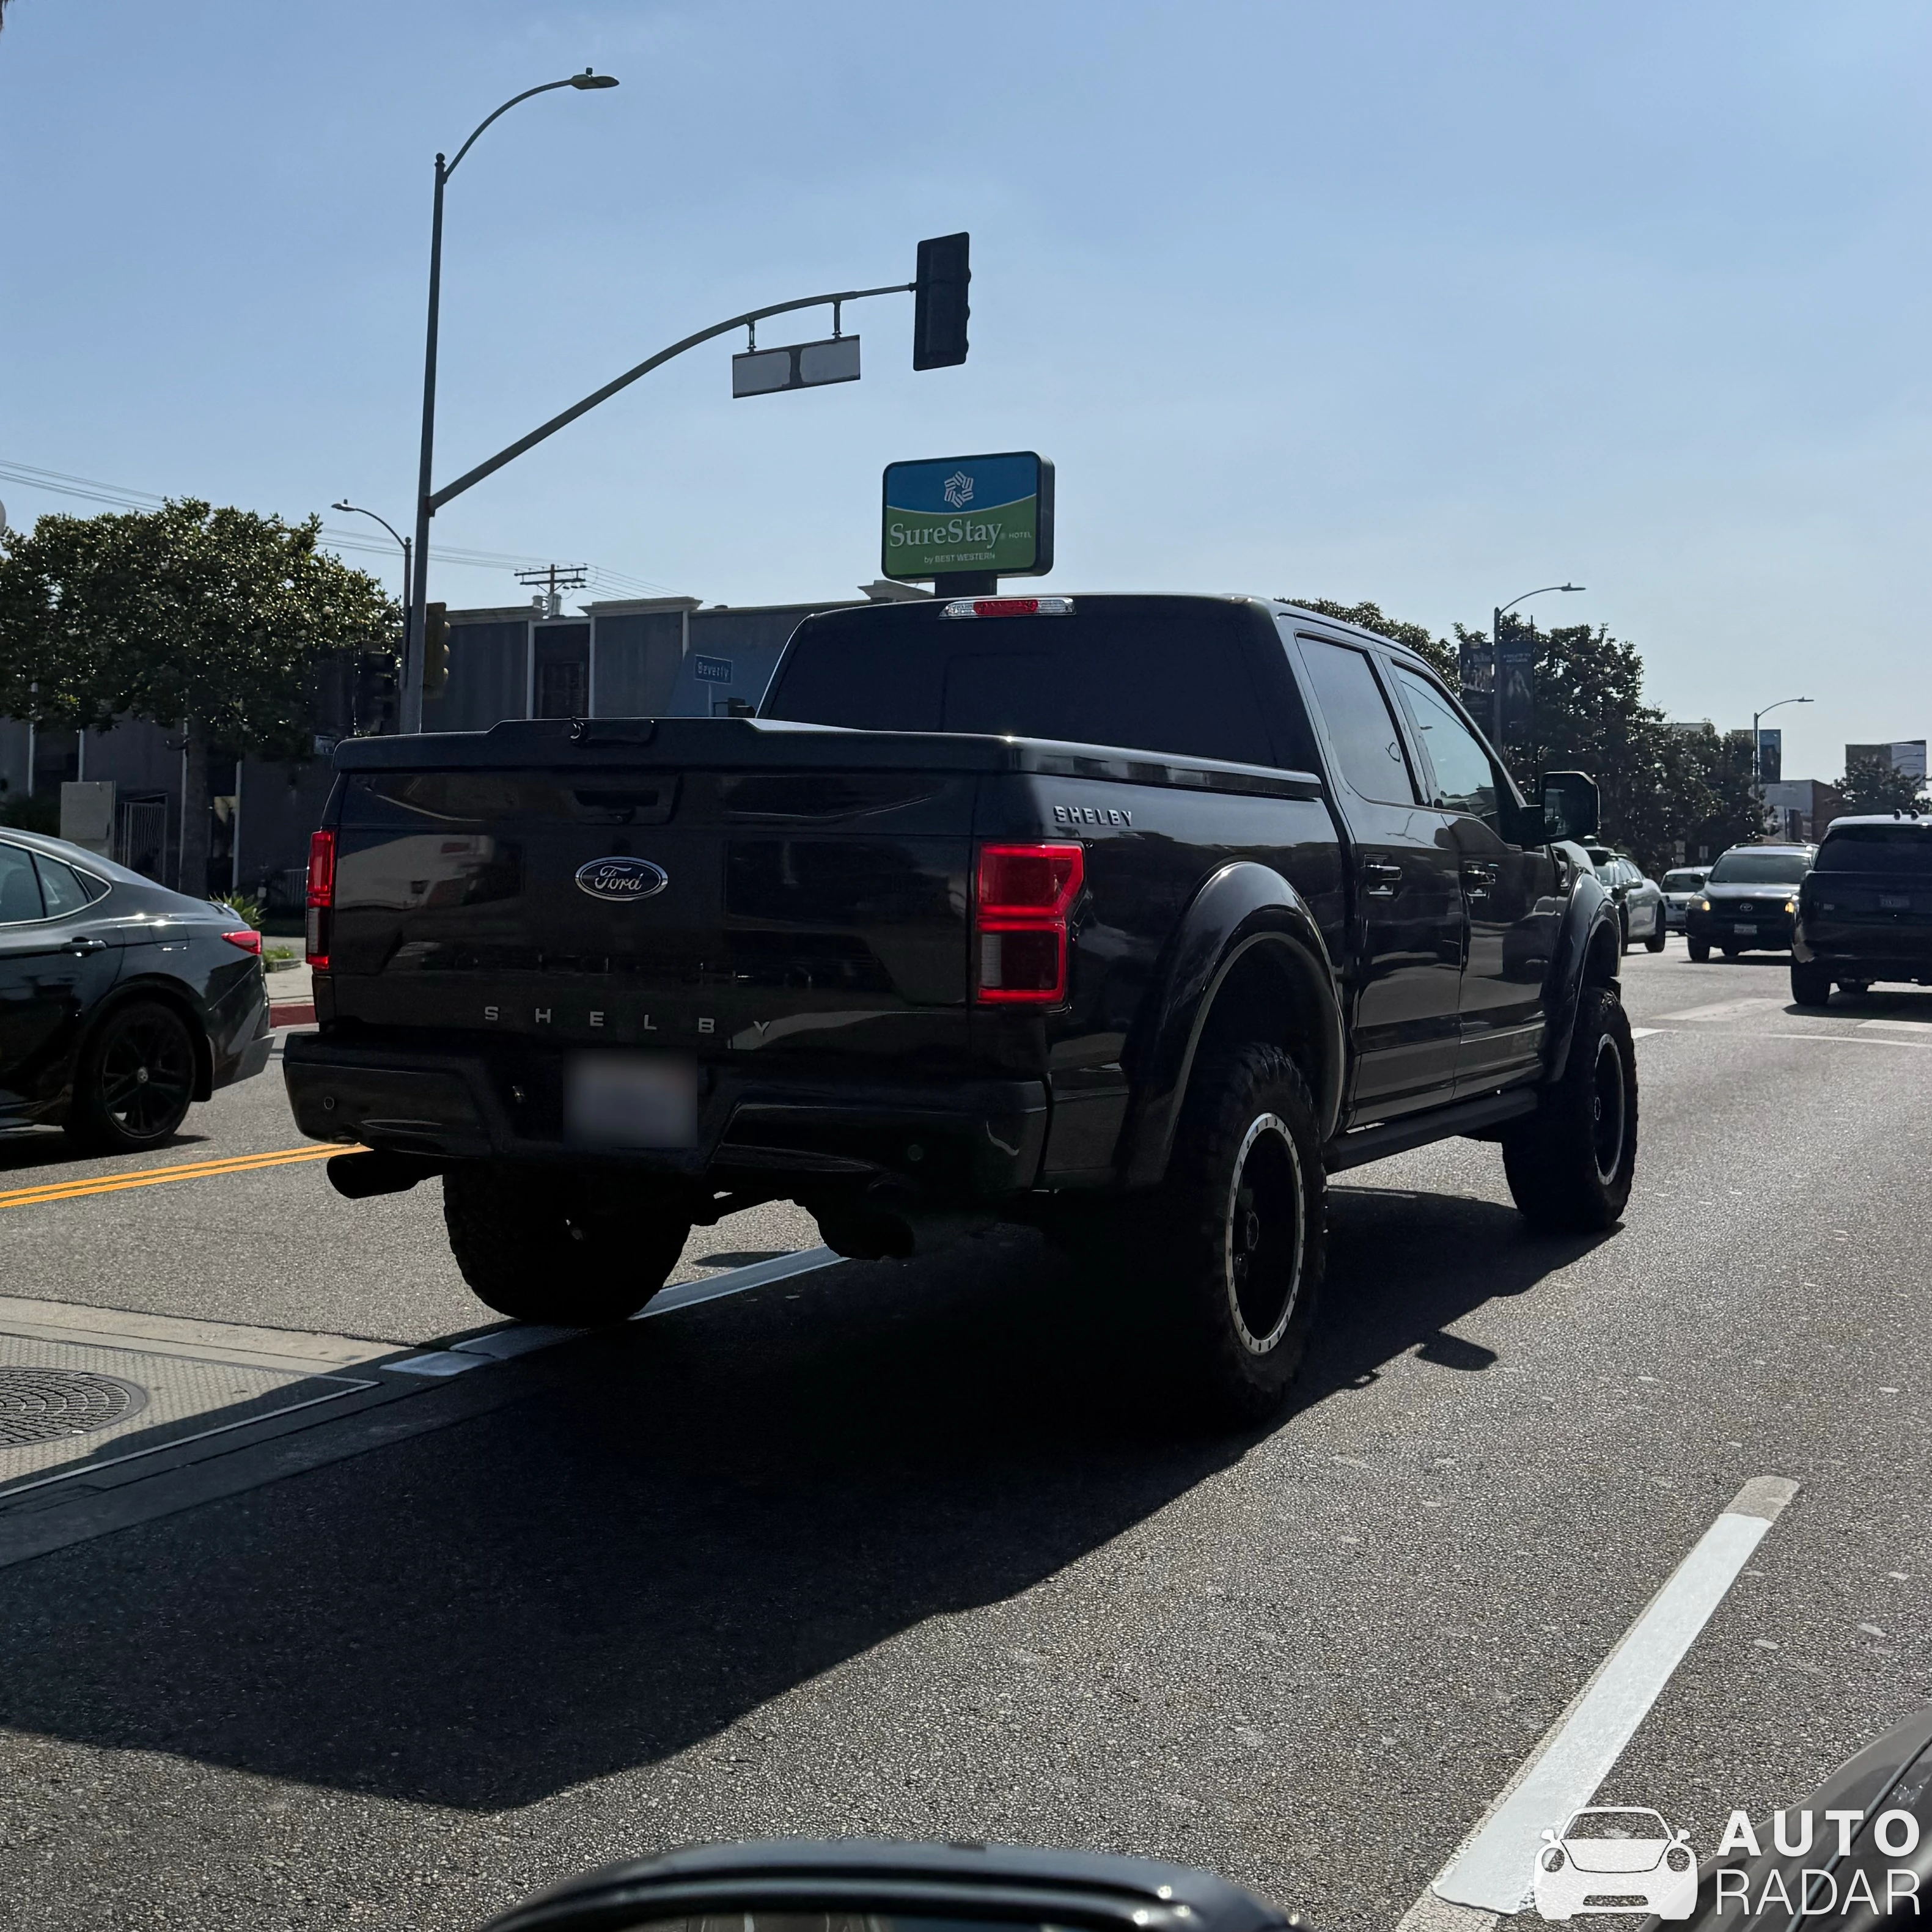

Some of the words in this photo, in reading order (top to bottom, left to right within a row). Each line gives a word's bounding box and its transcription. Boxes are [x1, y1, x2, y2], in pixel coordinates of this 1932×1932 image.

[889, 519, 1002, 548] SureStay
[935, 554, 955, 563] BEST
[957, 553, 995, 561] WESTERN
[697, 661, 729, 680] Beverly
[1053, 806, 1131, 826] SHELBY
[595, 865, 644, 890] Ford
[484, 1006, 770, 1035] SHELBY
